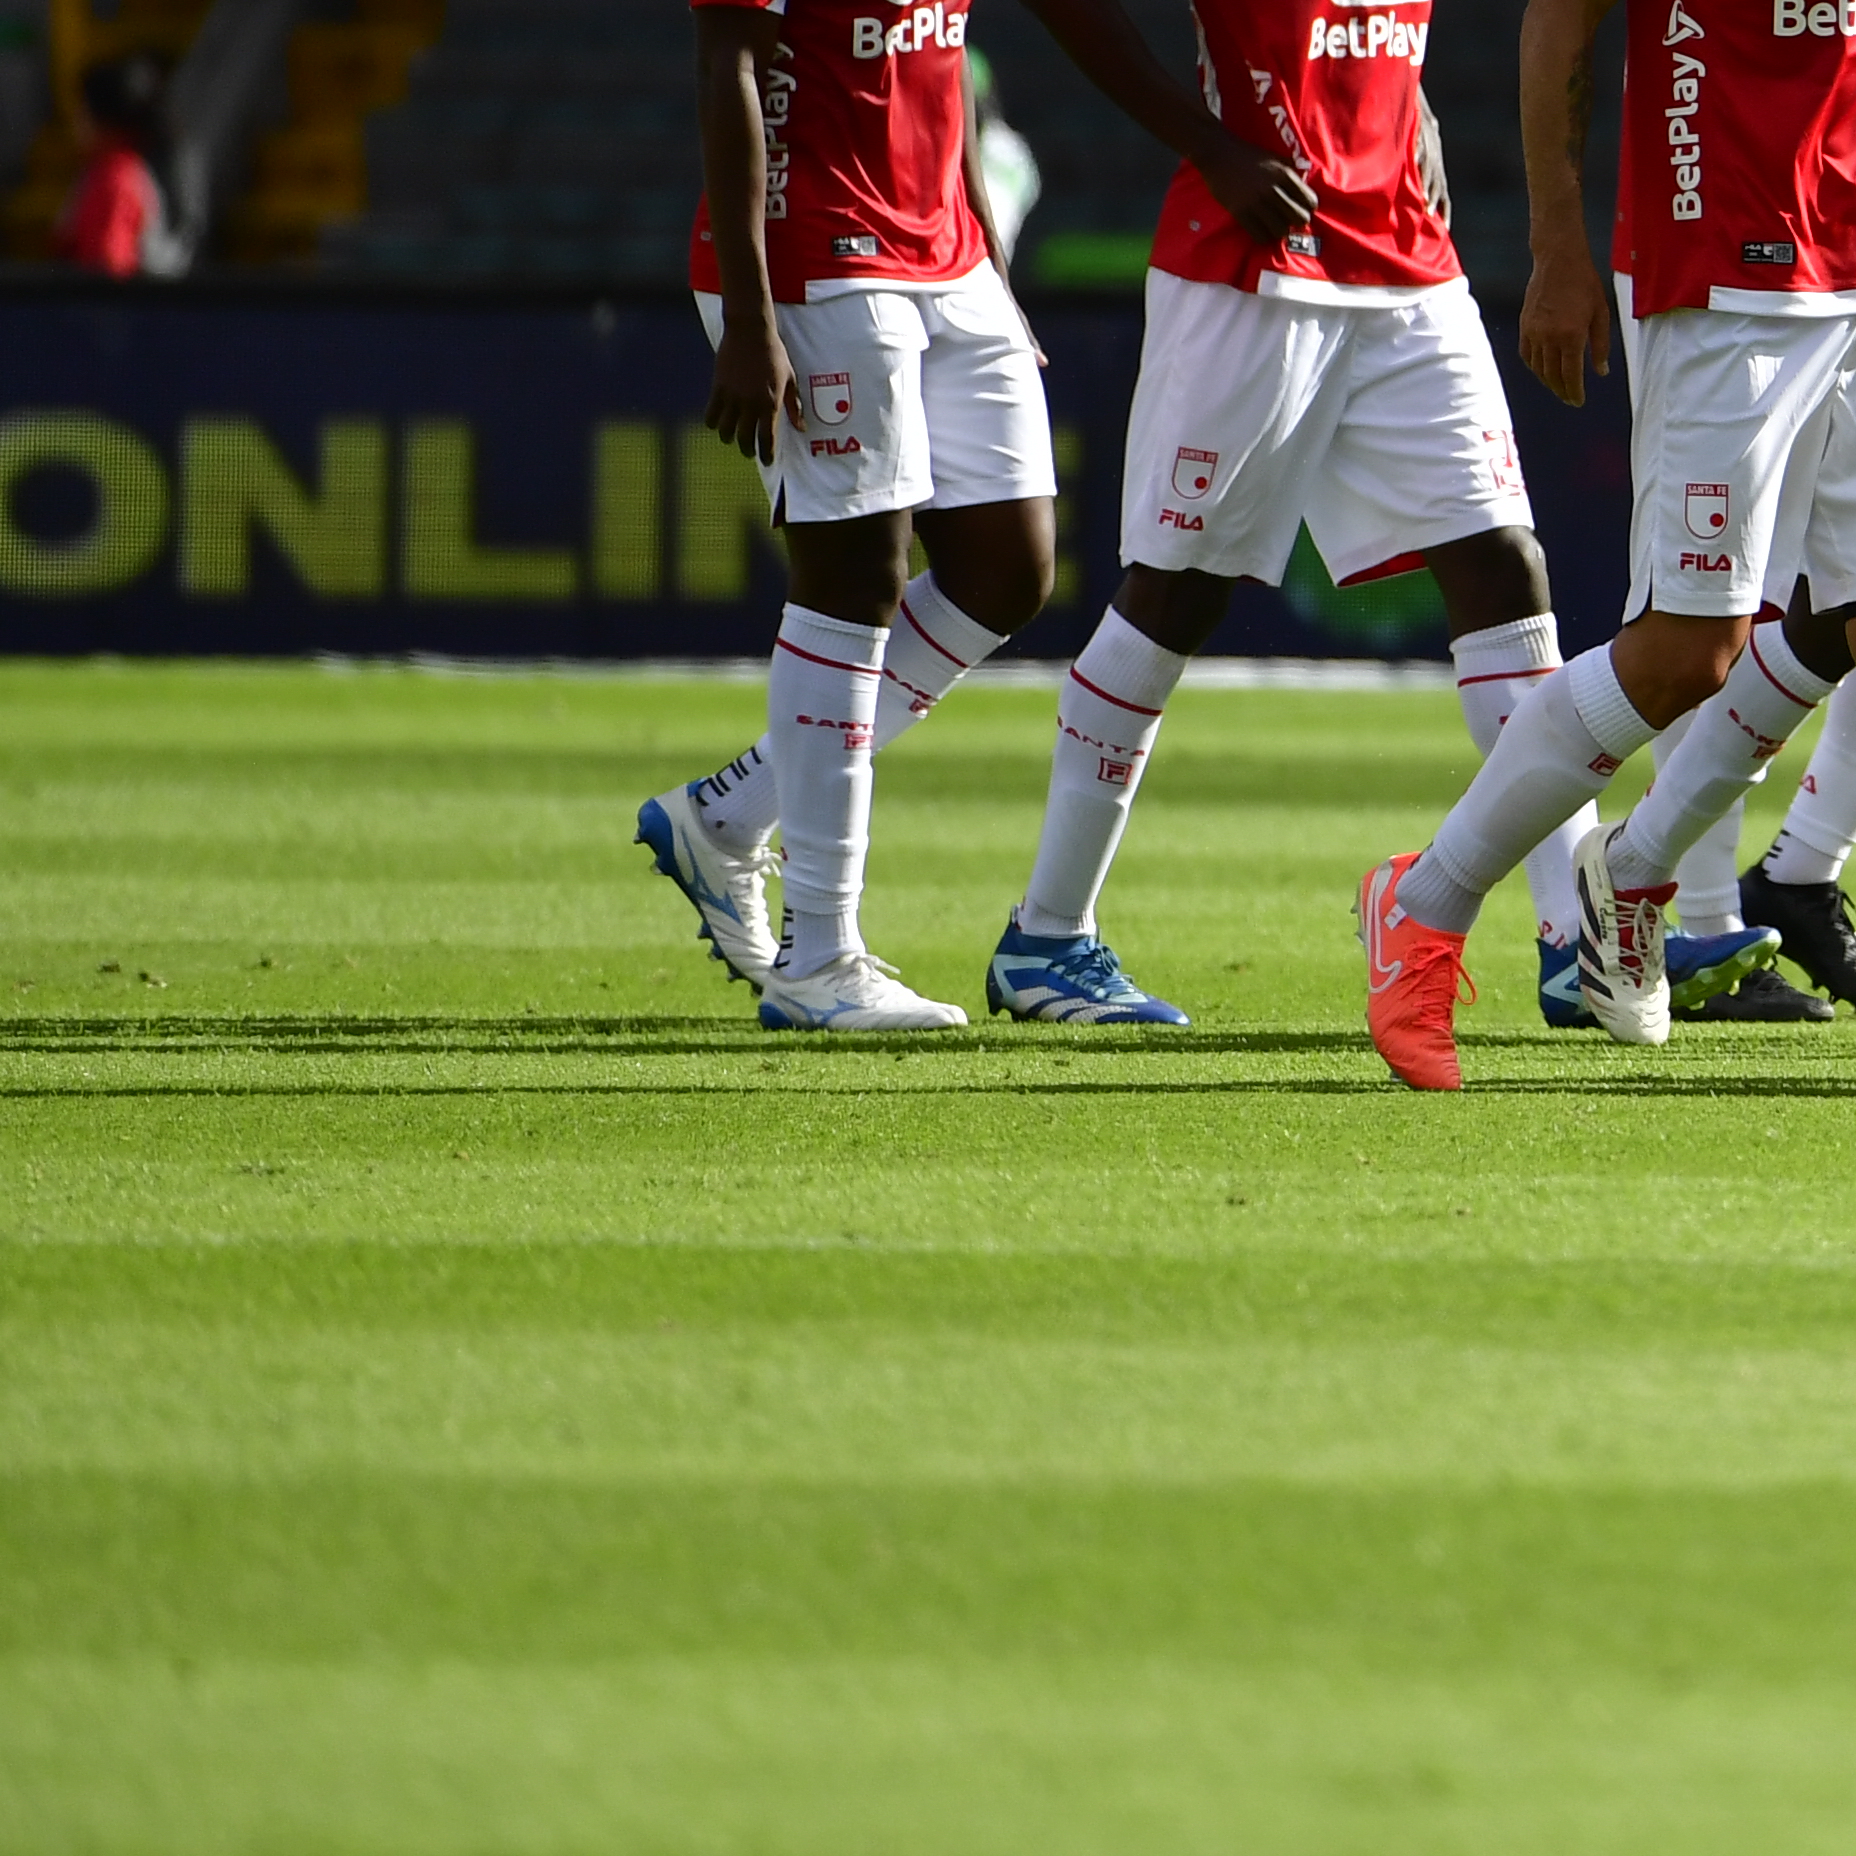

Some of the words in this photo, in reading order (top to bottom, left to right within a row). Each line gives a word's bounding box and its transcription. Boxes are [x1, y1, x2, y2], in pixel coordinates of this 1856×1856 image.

[1307, 11, 1429, 66] BetPlay
[1664, 51, 1706, 222] BetPlay
[810, 435, 861, 457] FILA
[1688, 485, 1715, 495] SANTA
[1717, 485, 1727, 495] FE
[1159, 508, 1205, 531] FILA
[1679, 552, 1732, 572] FILA
